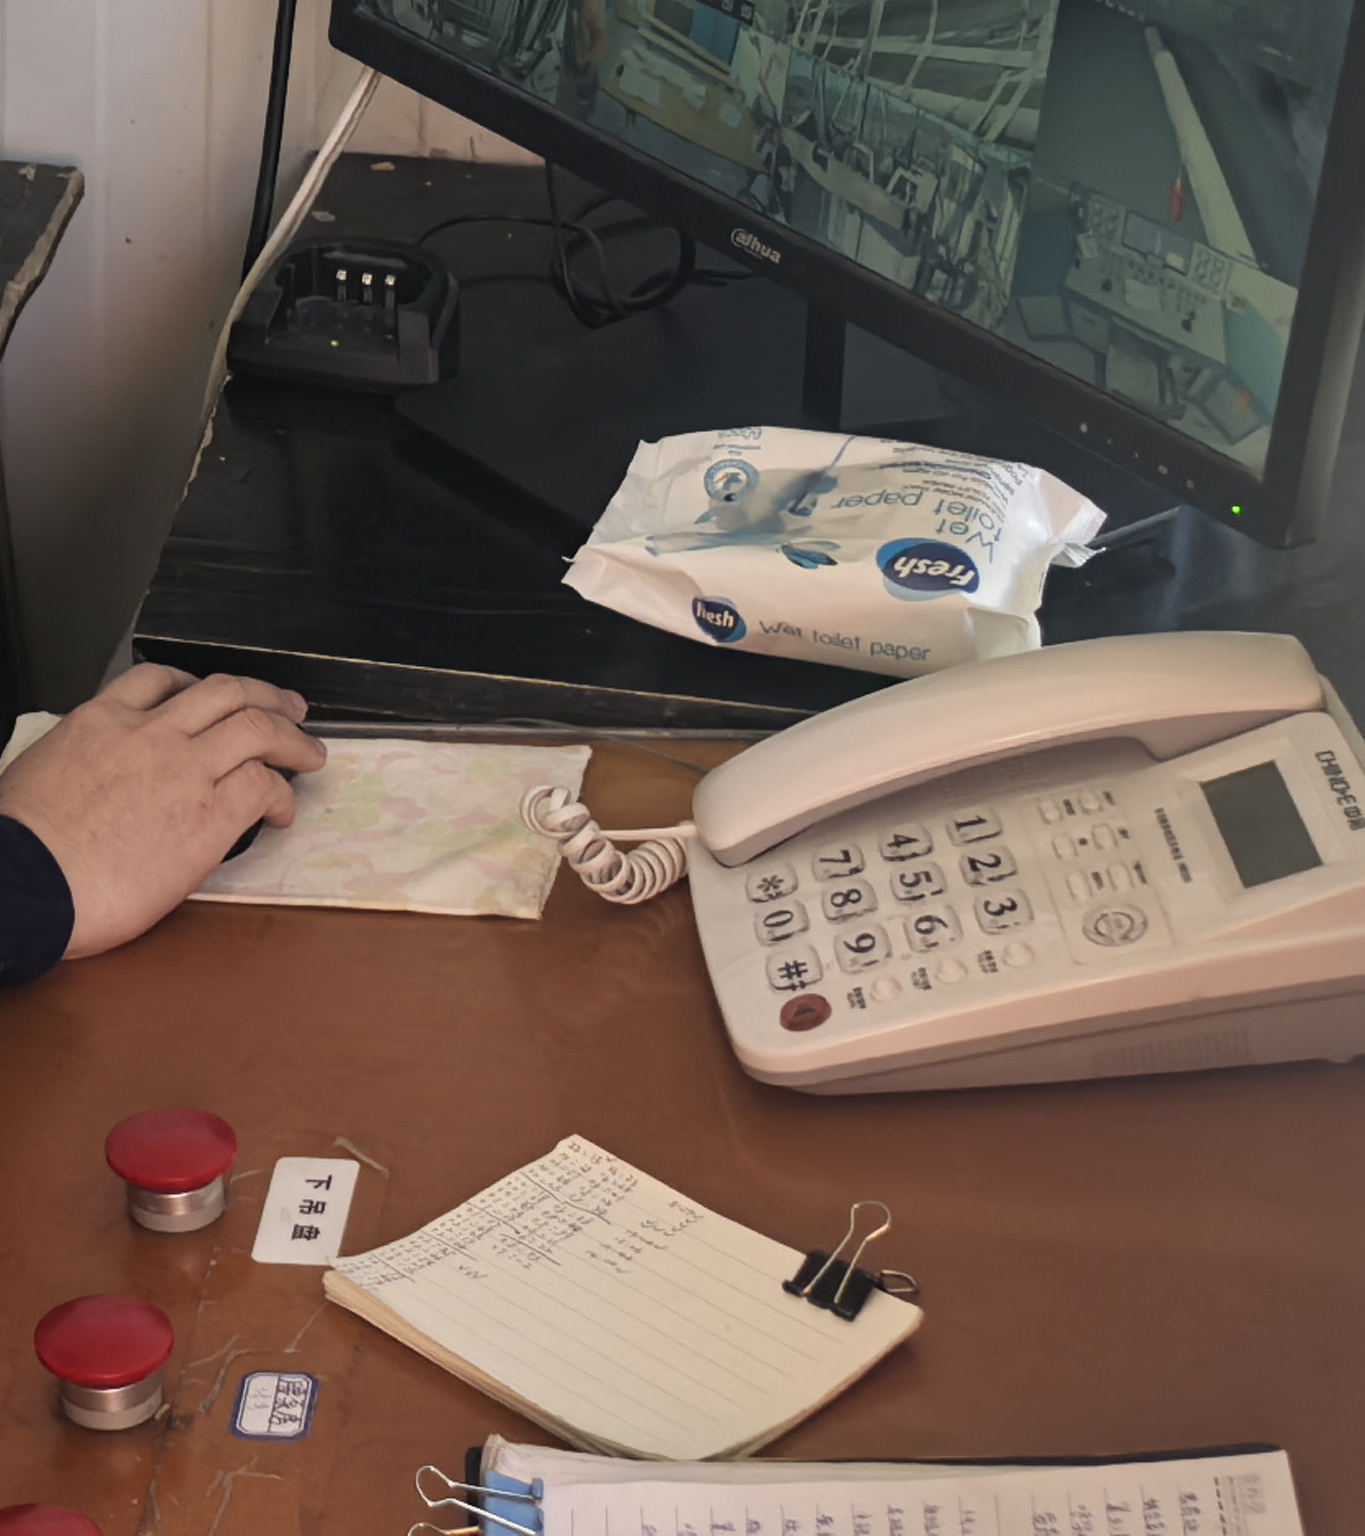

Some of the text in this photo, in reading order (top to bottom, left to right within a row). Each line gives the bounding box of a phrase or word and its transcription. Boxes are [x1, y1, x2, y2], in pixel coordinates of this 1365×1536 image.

[869, 639, 931, 663] paper
[954, 814, 986, 837] 1
[885, 832, 917, 857] 4
[819, 849, 851, 870] 7
[969, 853, 1002, 877] 2
[899, 871, 933, 890] 5
[831, 888, 864, 908] 8
[983, 897, 1017, 920] 3
[763, 910, 795, 931] 0
[914, 914, 949, 937] 6
[845, 932, 878, 956] 9
[290, 1173, 333, 1242] 下吊盘
